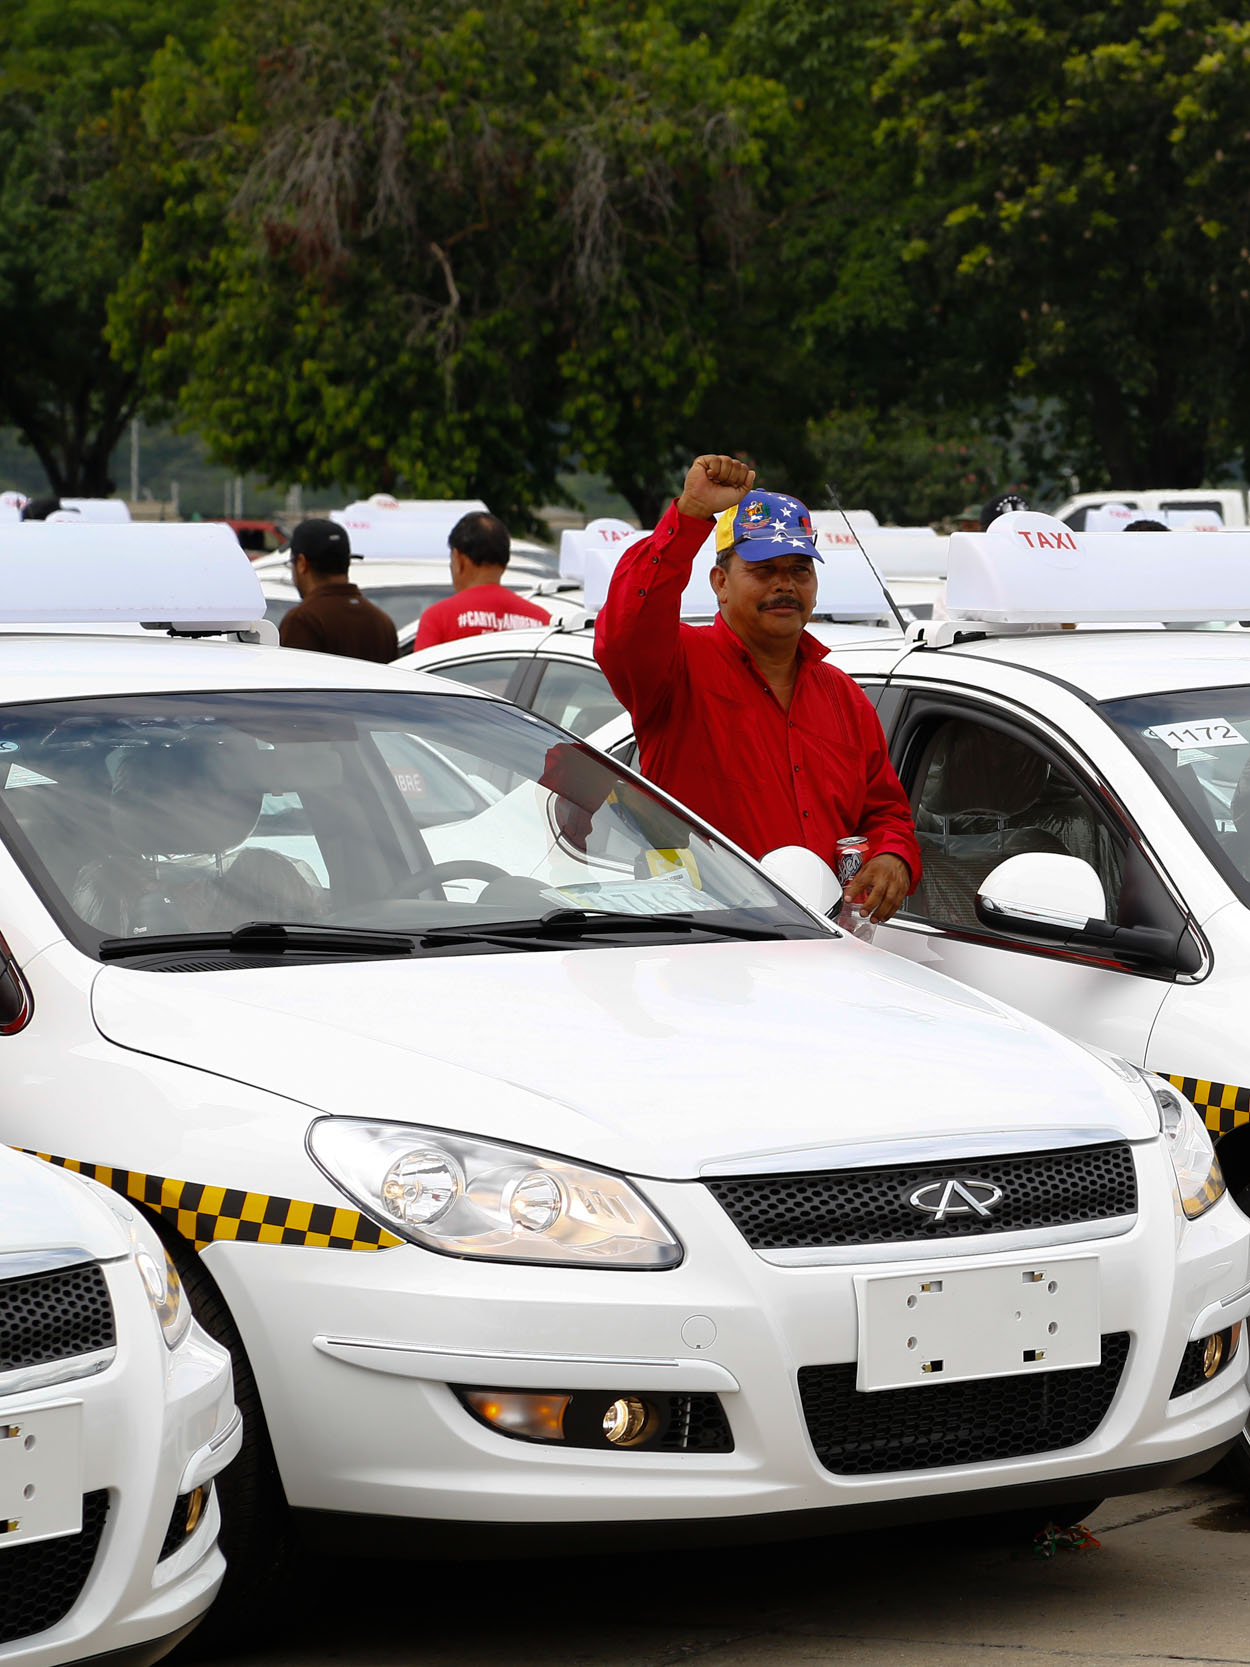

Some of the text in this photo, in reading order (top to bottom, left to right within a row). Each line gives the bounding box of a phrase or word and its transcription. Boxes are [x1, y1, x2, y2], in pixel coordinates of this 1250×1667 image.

[598, 530, 636, 542] TA
[1017, 531, 1077, 550] TAXI
[1167, 725, 1239, 743] 1172
[394, 774, 423, 792] IBRE
[837, 853, 863, 885] olden
